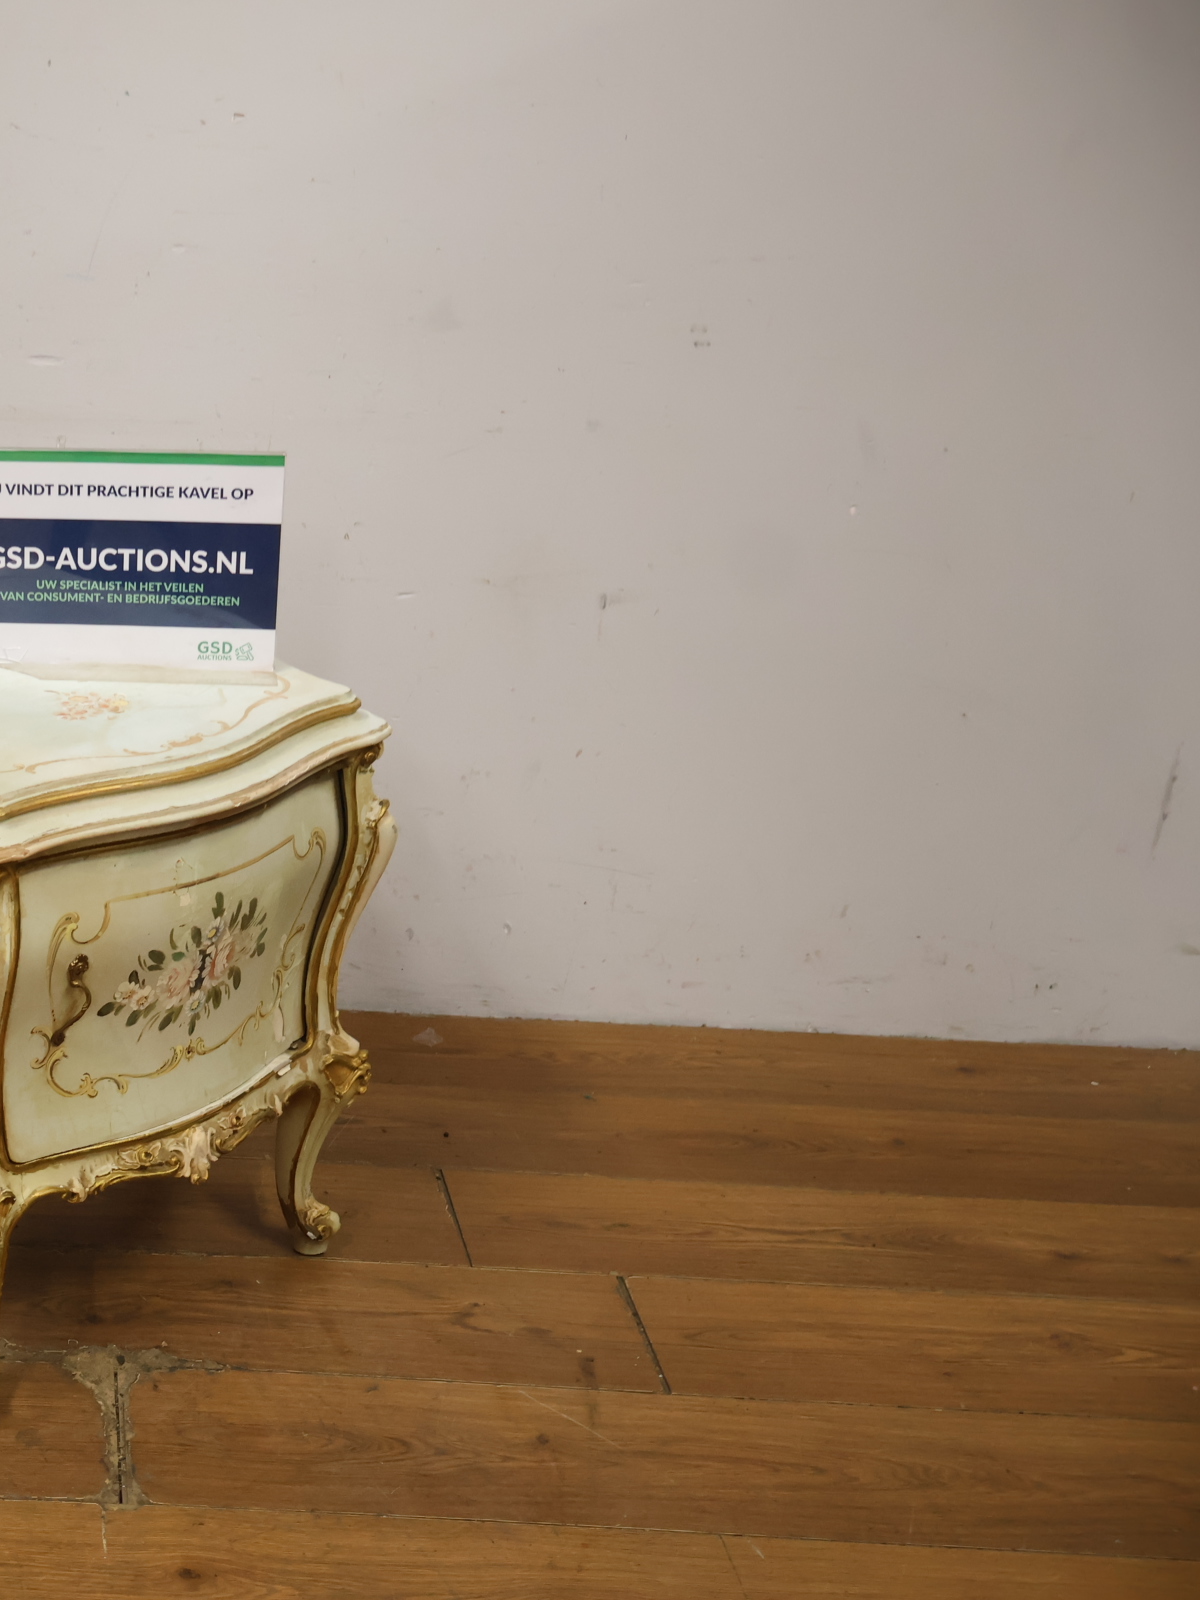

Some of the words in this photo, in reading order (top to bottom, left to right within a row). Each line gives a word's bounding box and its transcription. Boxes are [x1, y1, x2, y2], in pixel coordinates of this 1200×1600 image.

[5, 483, 54, 497] VINDT
[57, 484, 83, 497] DIT
[87, 485, 174, 499] PRACHTIGE
[178, 486, 228, 500] KAVEL
[231, 487, 254, 501] OP
[36, 580, 56, 590] UW
[60, 580, 122, 592] SPECIALIST
[124, 581, 137, 592] IN
[139, 582, 162, 593] HET
[163, 582, 204, 593] VEILEN
[0, 591, 24, 602] VAN
[27, 592, 104, 603] CONSUMENT-
[107, 594, 123, 604] EN
[125, 594, 240, 607] BEDRIJFSGOEDEREN
[197, 641, 233, 654] GSD
